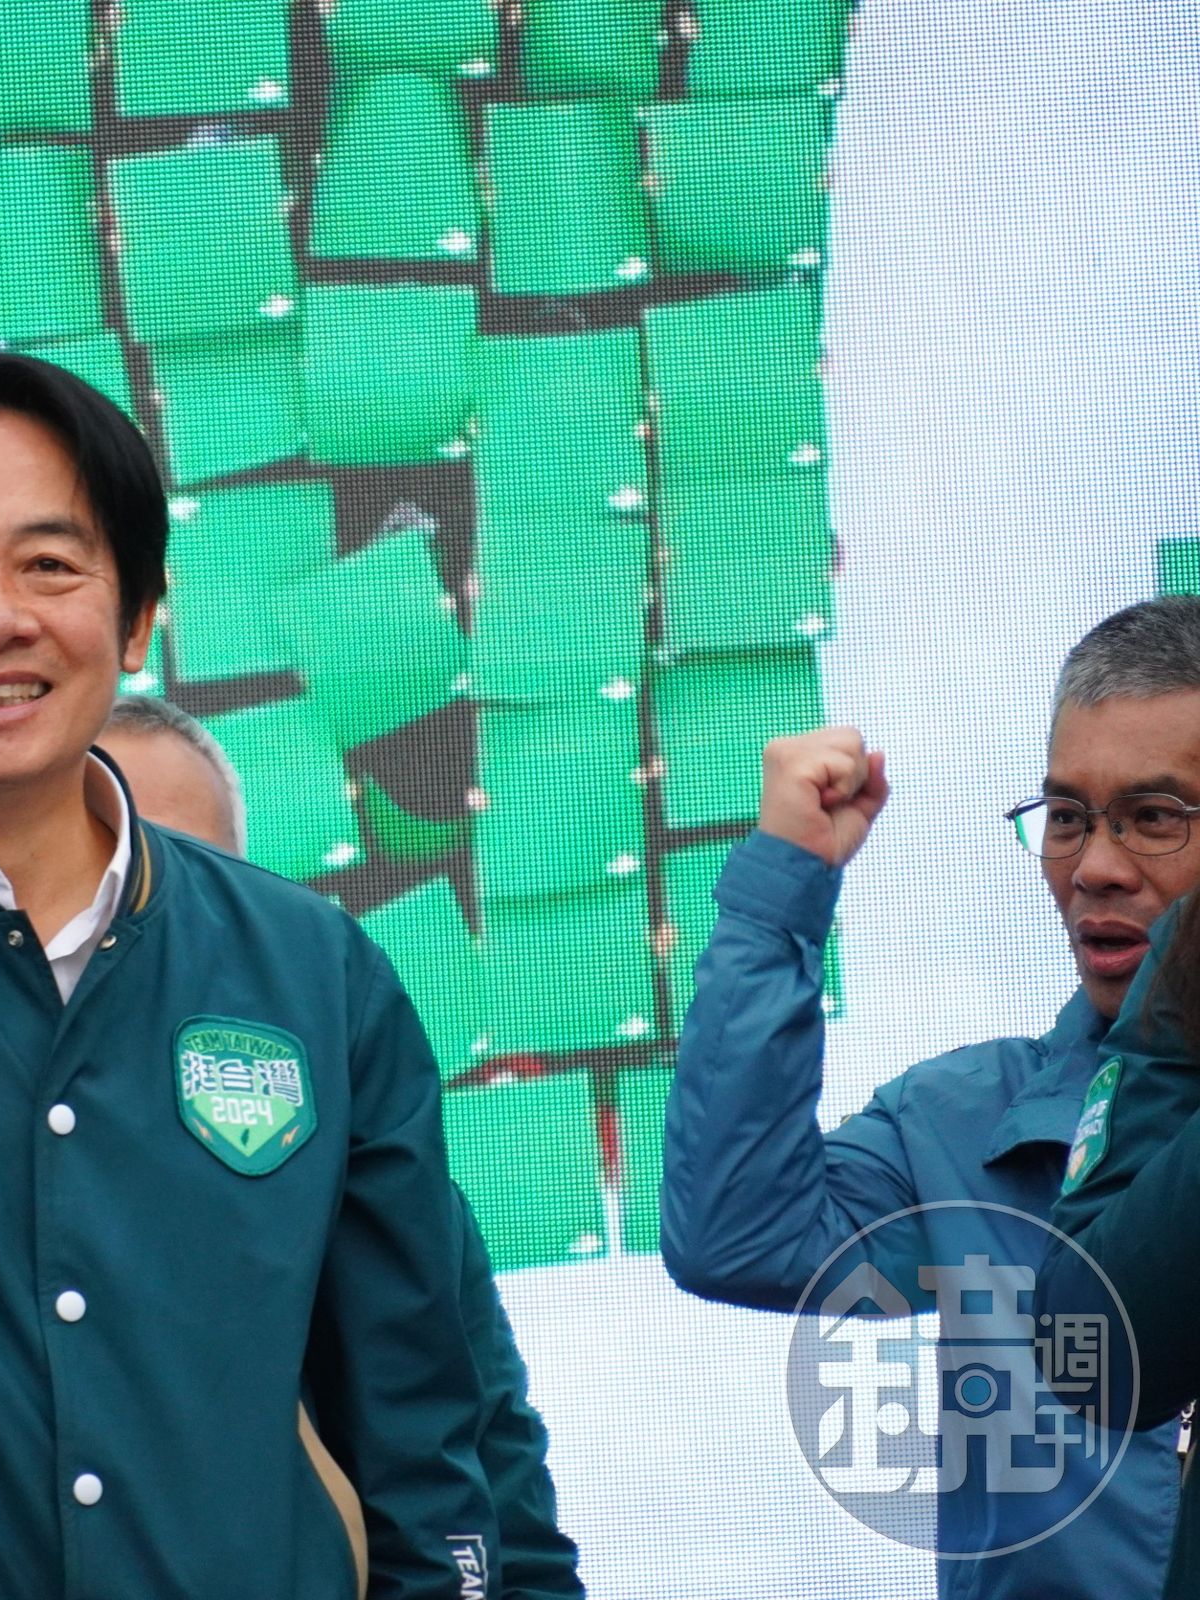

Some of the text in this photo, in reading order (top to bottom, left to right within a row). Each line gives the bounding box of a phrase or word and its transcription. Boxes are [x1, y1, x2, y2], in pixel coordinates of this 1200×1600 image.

[185, 1030, 292, 1060] TEAM TAIWAN
[210, 1096, 274, 1125] 2024
